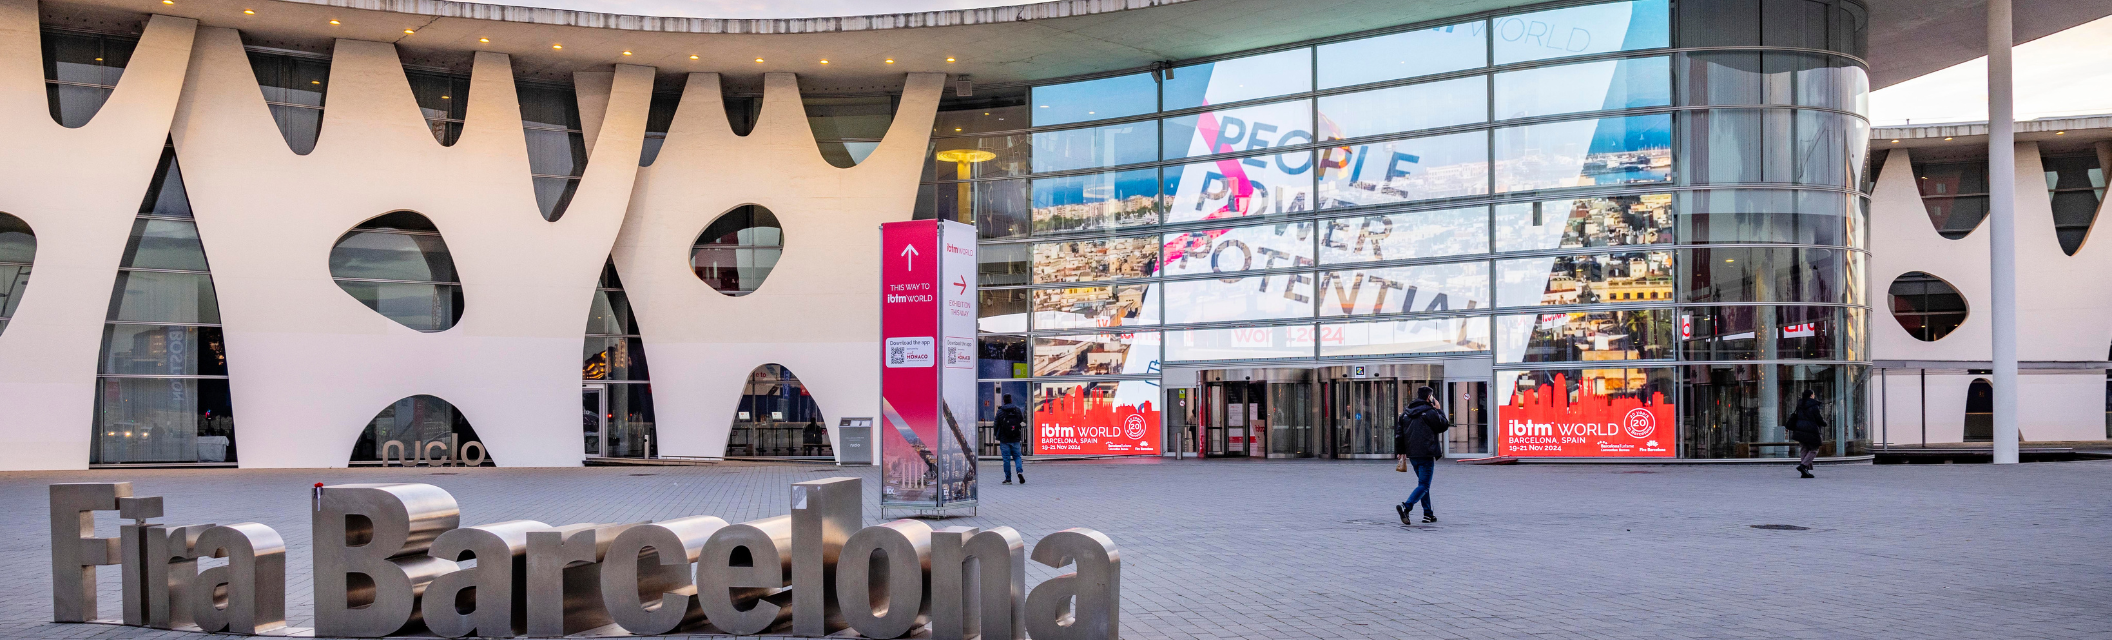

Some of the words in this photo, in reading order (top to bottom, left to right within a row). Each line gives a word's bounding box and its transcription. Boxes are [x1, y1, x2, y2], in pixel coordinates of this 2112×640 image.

[1212, 114, 1420, 199] PEOPLE
[1195, 170, 1393, 261] POWER
[887, 294, 907, 304] ibtm
[907, 294, 933, 303] WORLD
[889, 284, 905, 292] THIS
[1178, 232, 1487, 350] POTENTIAL
[1041, 423, 1075, 438] ibtm
[1077, 426, 1121, 438] WORLD
[1508, 419, 1552, 437] ibtm
[1557, 423, 1619, 436] WORLD
[1632, 419, 1646, 427] 20
[382, 432, 486, 467] nuclo
[48, 481, 286, 636] Fira
[311, 477, 1121, 640] Barcelona
